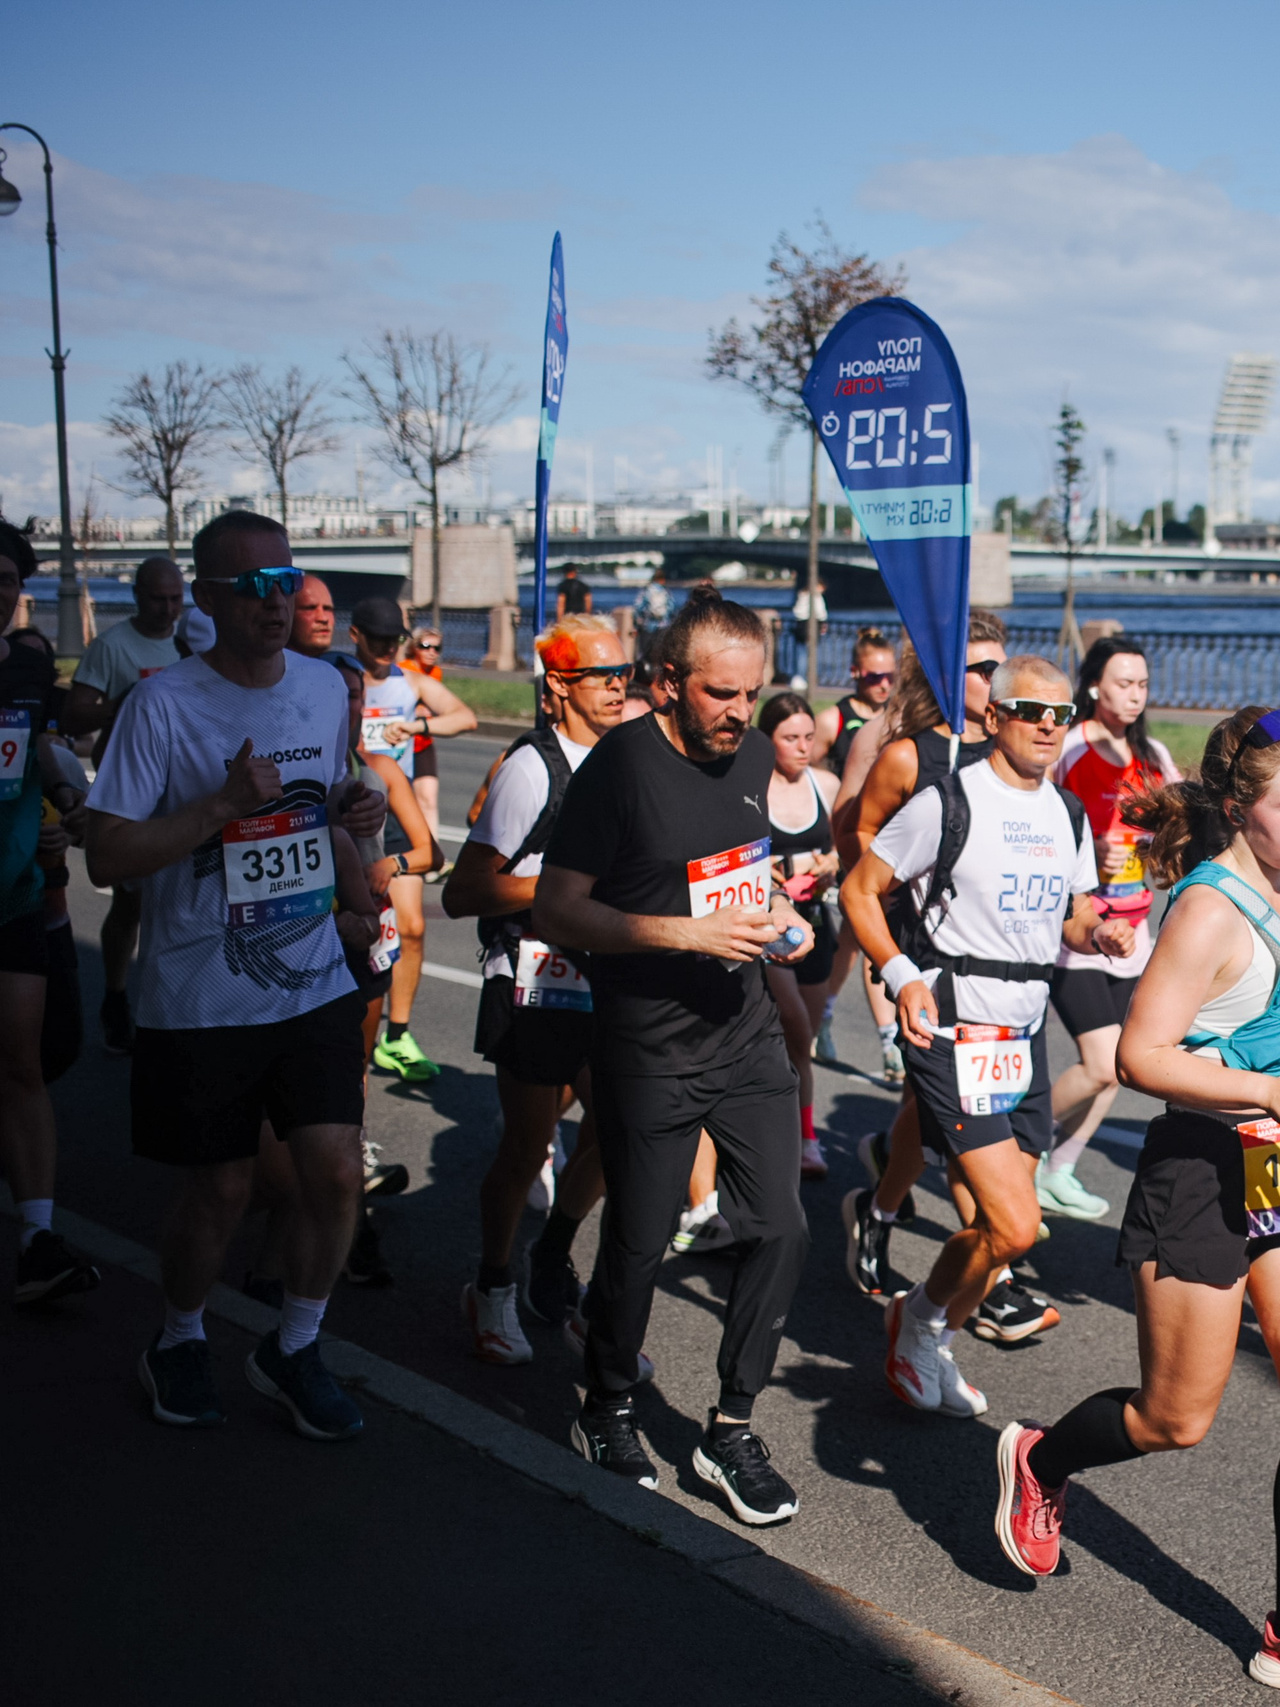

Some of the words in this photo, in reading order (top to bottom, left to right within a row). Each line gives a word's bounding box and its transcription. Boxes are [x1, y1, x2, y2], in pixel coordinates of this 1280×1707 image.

[1003, 821, 1031, 832] ПОЛУ
[1003, 833, 1054, 845] МАРАФОН
[241, 837, 321, 883] 3315
[268, 877, 305, 894] ДЕНИС
[705, 876, 765, 911] 7206
[998, 873, 1064, 912] 2:09
[242, 905, 256, 923] E
[528, 991, 539, 1005] E
[971, 1053, 1022, 1082] 7619
[977, 1097, 986, 1112] E
[1259, 1211, 1274, 1231] D
